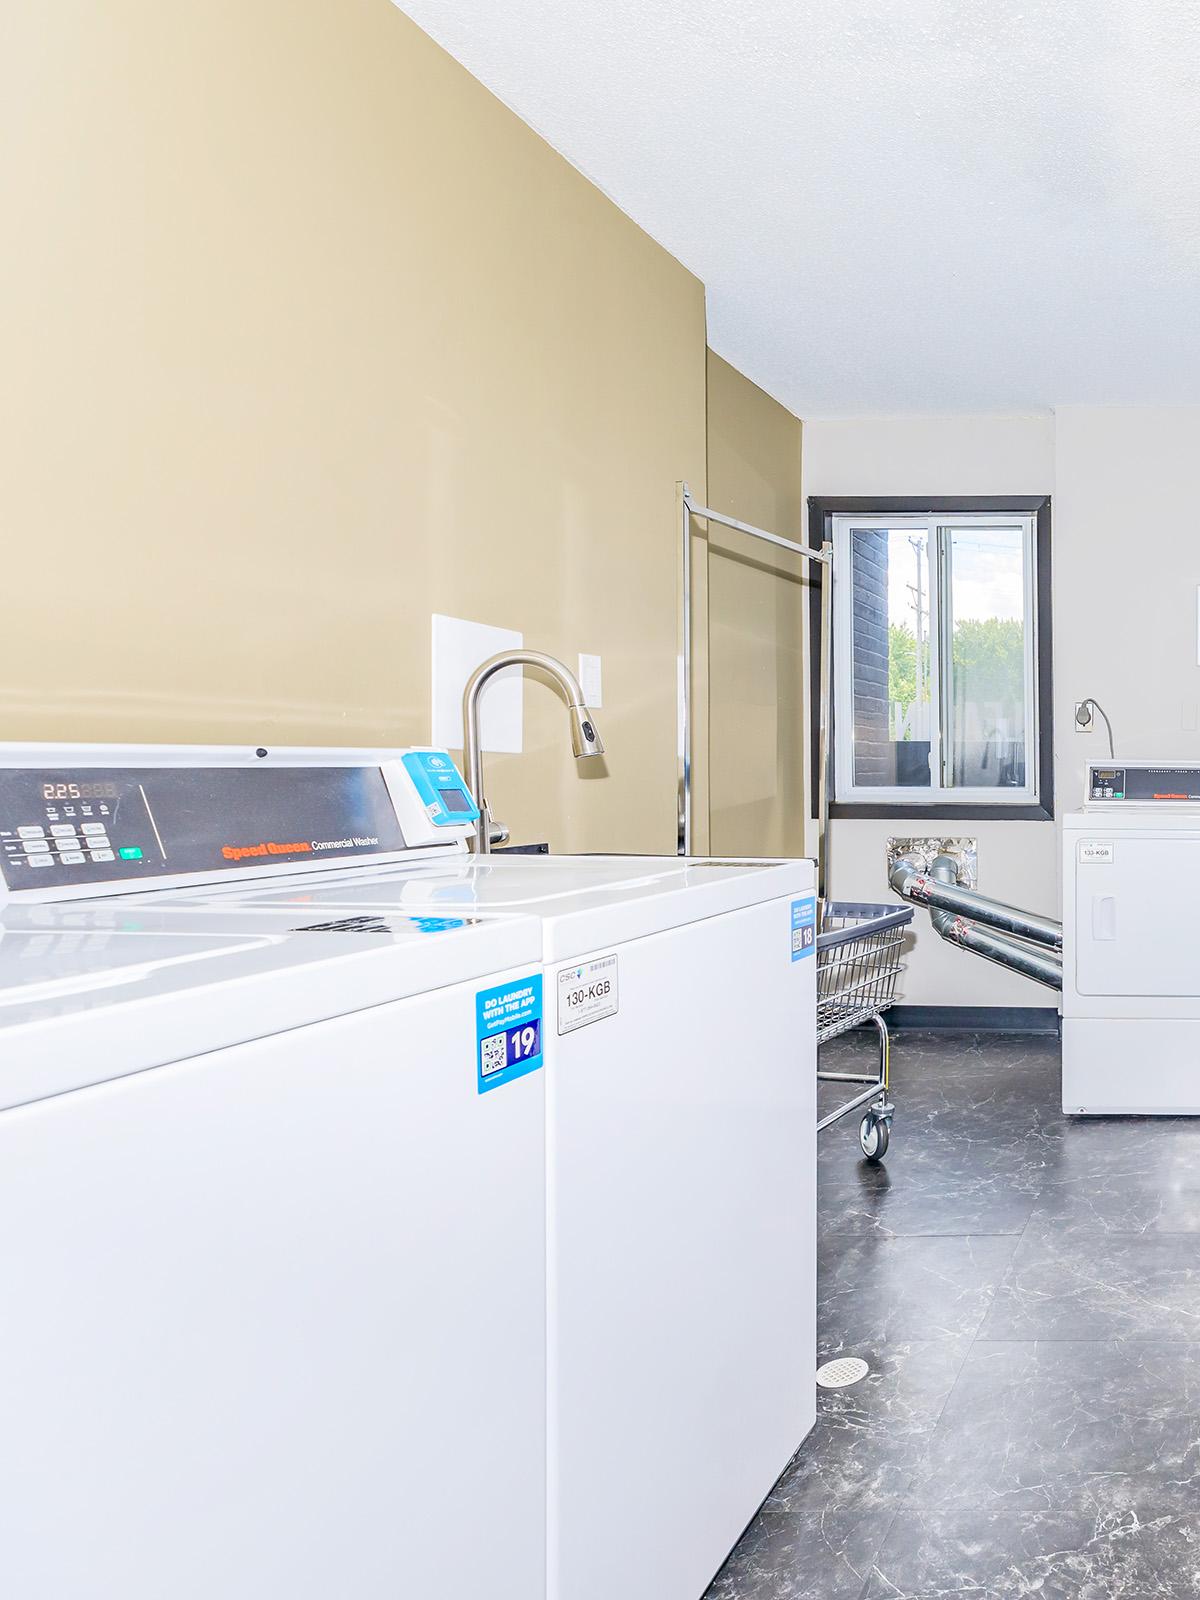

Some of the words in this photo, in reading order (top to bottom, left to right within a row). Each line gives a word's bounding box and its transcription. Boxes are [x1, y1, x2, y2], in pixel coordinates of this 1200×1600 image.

[222, 844, 268, 861] Speed
[268, 841, 310, 855] Queen
[311, 840, 352, 851] Commercial
[353, 837, 379, 847] Washer
[803, 927, 812, 945] 18
[485, 998, 497, 1010] DO
[498, 987, 533, 1004] LAUNDRY
[566, 980, 611, 1007] 130-KGB
[483, 1006, 504, 1020] WITH
[505, 1001, 520, 1012] THE
[521, 996, 536, 1007] APP
[511, 1026, 535, 1059] 19
